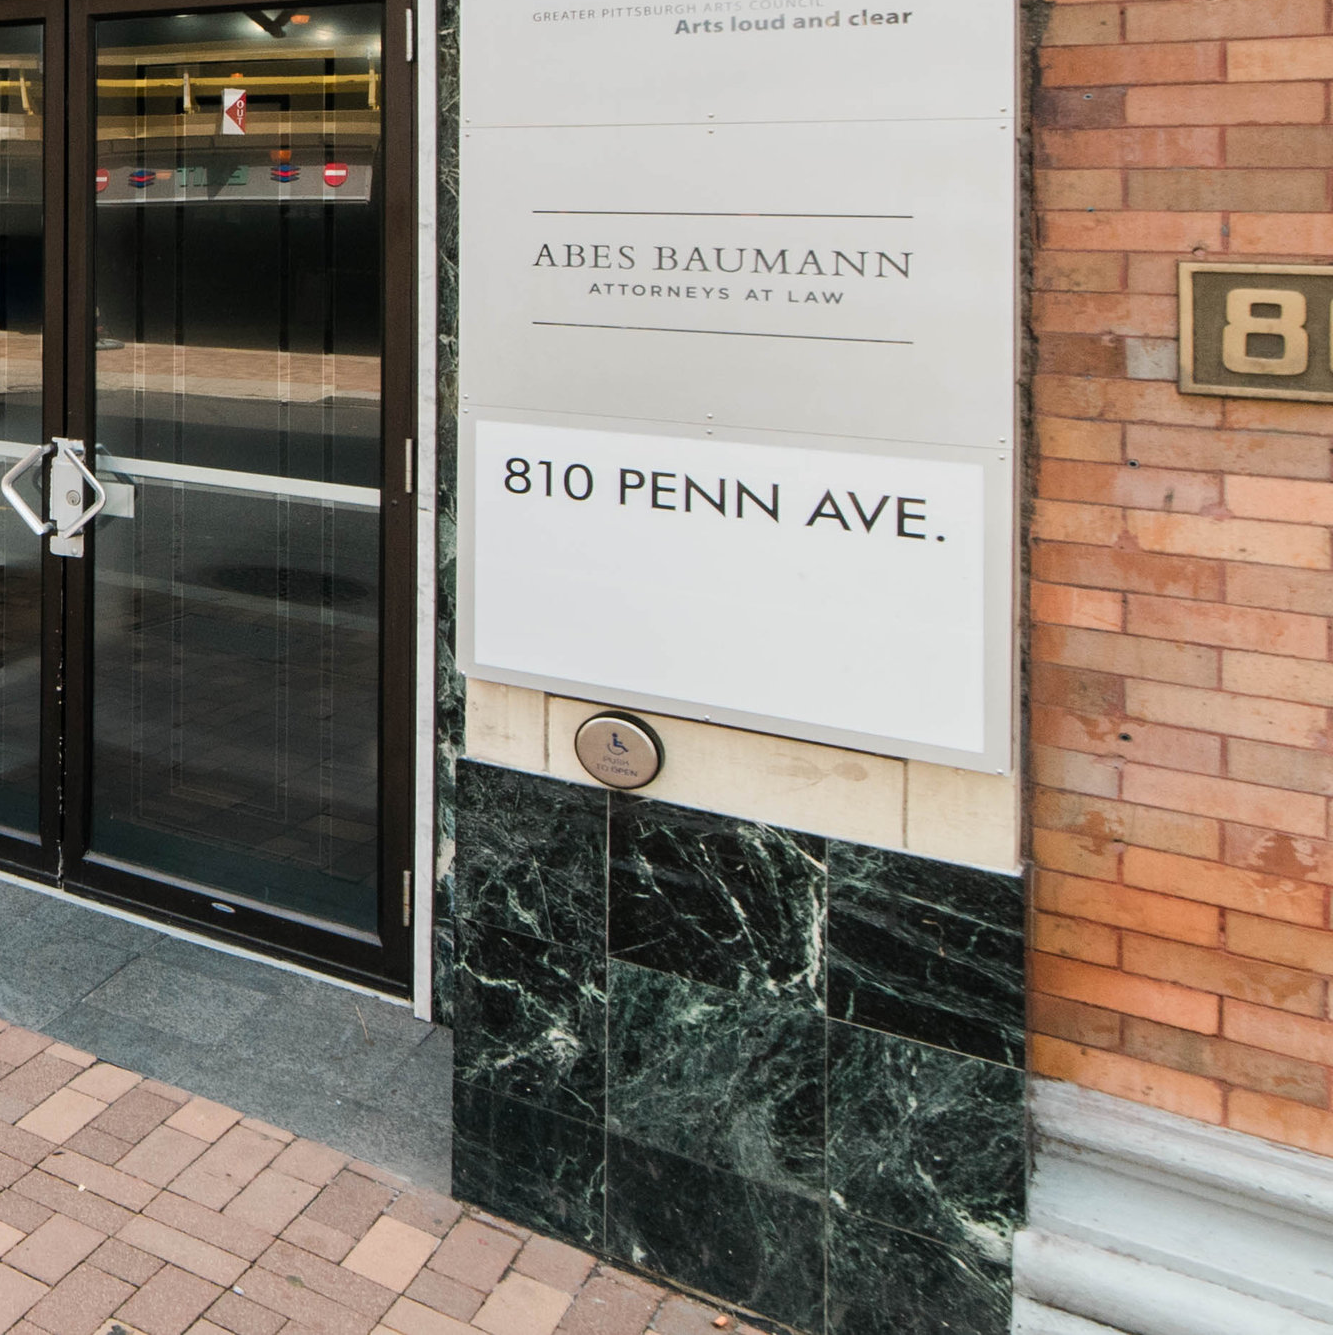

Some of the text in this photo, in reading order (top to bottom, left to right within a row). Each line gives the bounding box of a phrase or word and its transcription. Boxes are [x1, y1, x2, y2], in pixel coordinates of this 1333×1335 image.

[532, 9, 596, 23] GREATER
[601, 4, 697, 19] PITTSBURGH
[703, 0, 743, 13] ARTS
[674, 8, 913, 35] Arts loud and clear
[236, 99, 245, 126] OUT
[533, 242, 915, 280] ABES BAUMANN
[588, 281, 845, 305] ATTORNEYS AT LAW
[1223, 288, 1333, 377] 8
[502, 456, 947, 544] 810 PENN AVE.
[610, 765, 638, 777] OPEN
